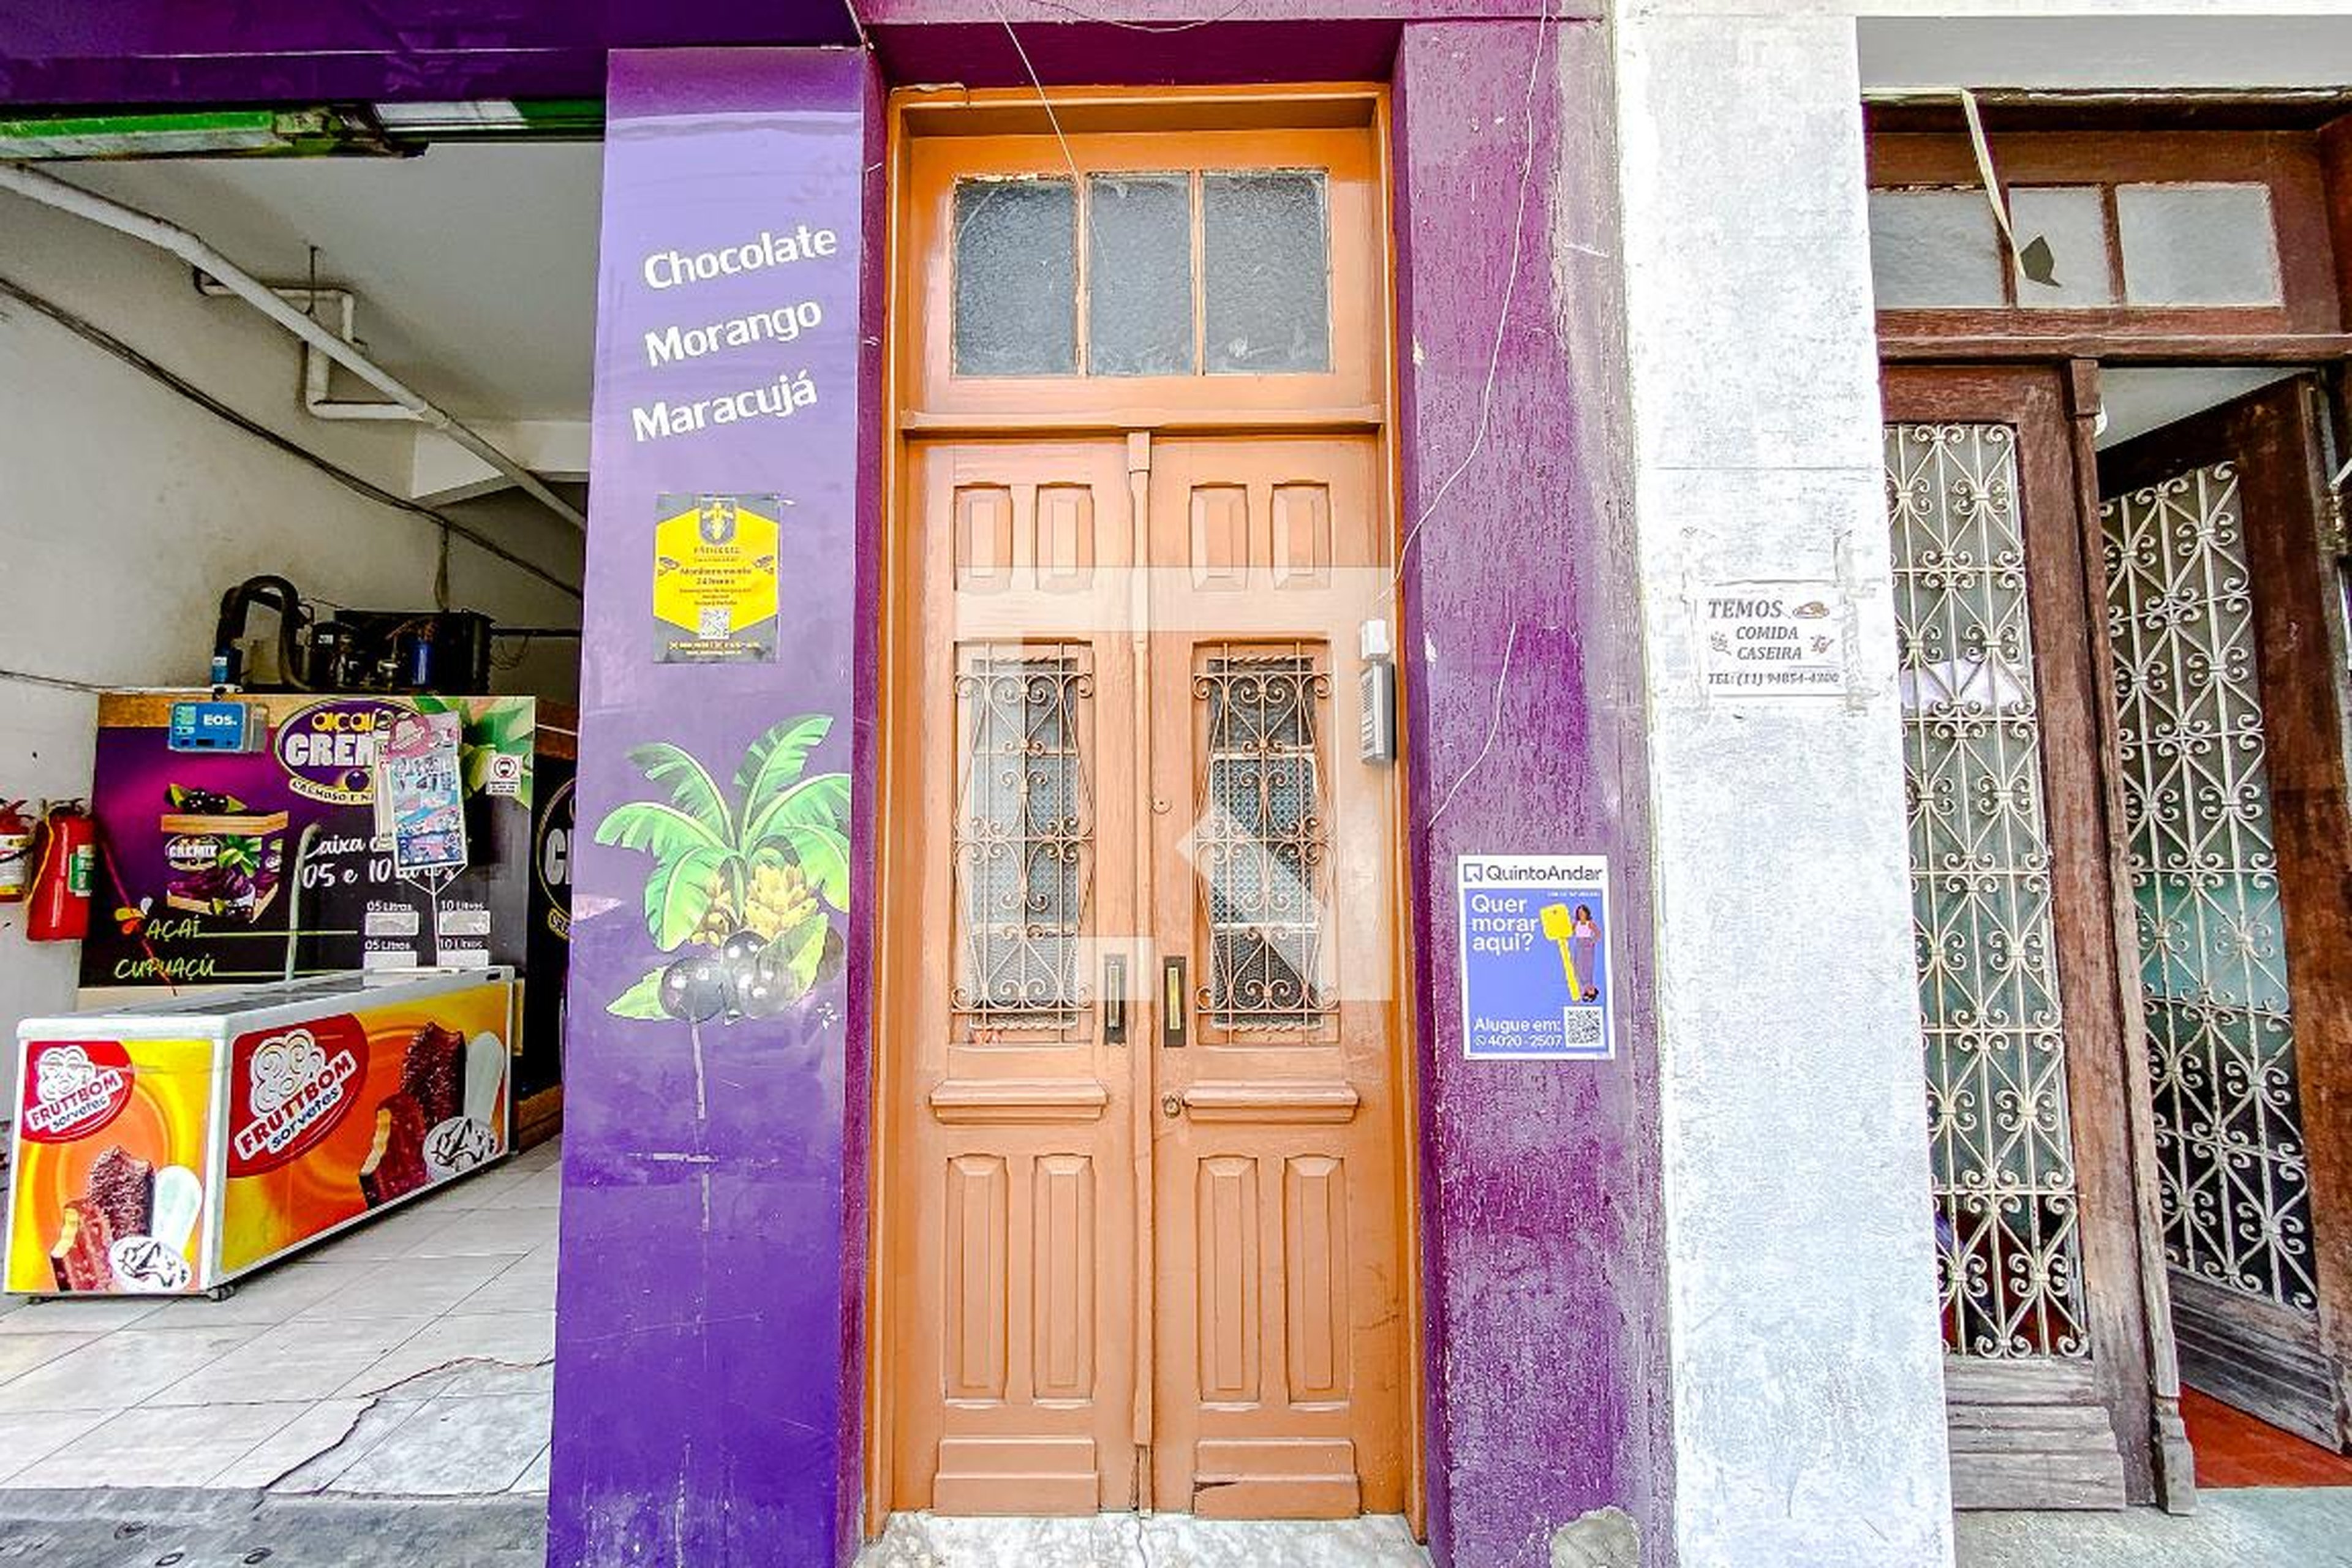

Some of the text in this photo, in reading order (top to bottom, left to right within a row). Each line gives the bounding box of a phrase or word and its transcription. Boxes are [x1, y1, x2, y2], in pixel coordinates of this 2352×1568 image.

[644, 225, 837, 289] Chocolate
[644, 301, 822, 367] Morango
[631, 369, 818, 442] Maracujá
[1708, 599, 1783, 619] TEMOS
[1736, 626, 1799, 640] COMIDA
[1736, 646, 1803, 660] CASEIRA
[303, 862, 336, 888] 05
[343, 869, 358, 884] e
[369, 858, 393, 883] 10
[1486, 864, 1603, 881] QuintoAndar
[367, 900, 382, 911] 05
[442, 900, 454, 911] 10
[1471, 894, 1528, 913] Quer
[146, 914, 201, 942] AÇAÍ
[1472, 917, 1539, 932] morar
[1472, 932, 1534, 956] aqui?
[1474, 1017, 1562, 1035] Alugue em:
[30, 1072, 119, 1126] FRUTTBOM
[239, 1054, 352, 1155] FRUTTBOM
[271, 1087, 339, 1149] sorvetes
